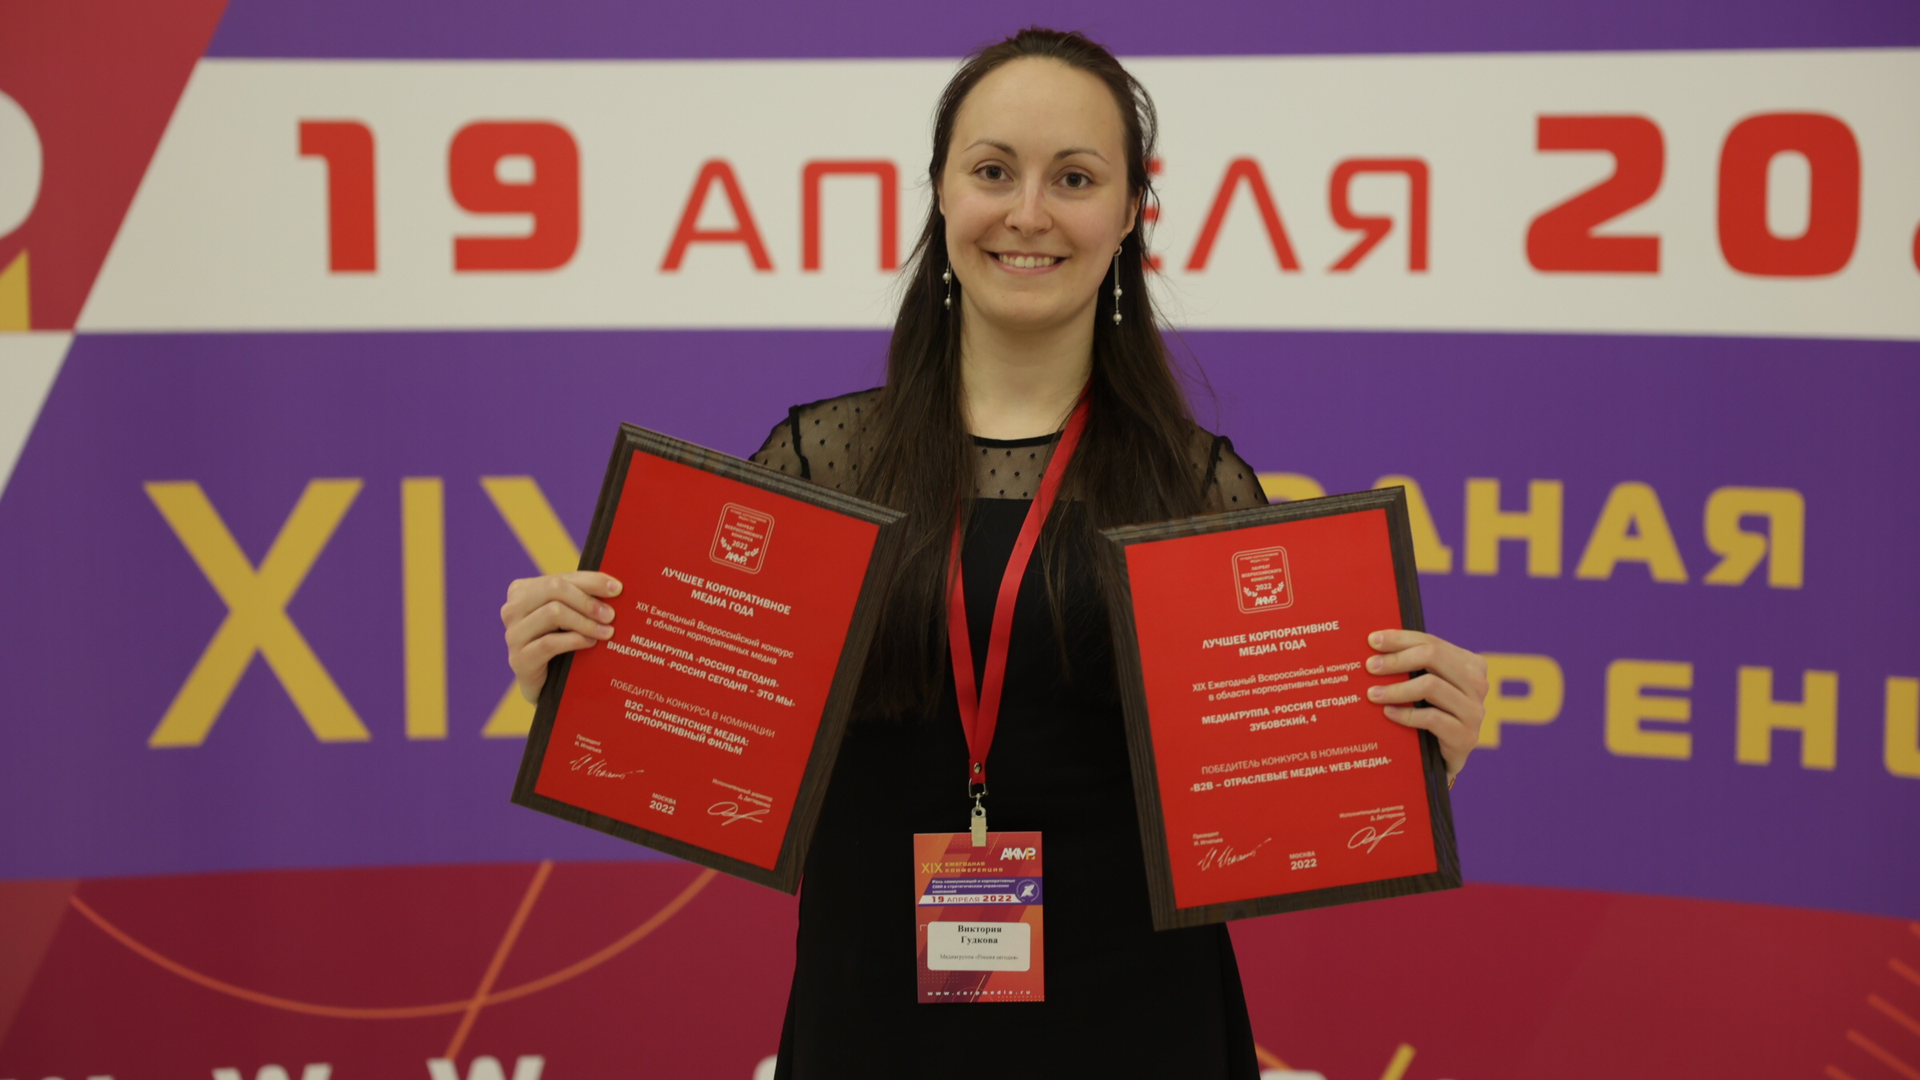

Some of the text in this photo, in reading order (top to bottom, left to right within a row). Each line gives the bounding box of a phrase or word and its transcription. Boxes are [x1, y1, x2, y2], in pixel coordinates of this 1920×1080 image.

[298, 118, 582, 275] 19
[1525, 110, 1920, 279] 20
[730, 539, 748, 550] 2022
[660, 566, 791, 615] ЛУЧШЕЕ КОРПОРАТИВНОЕ
[1255, 582, 1272, 591] 2022
[690, 588, 754, 617] МЕДИА ГОДА
[635, 600, 794, 658] XIX Ежегодный Всероссийский конкурс
[645, 617, 777, 665] в области корпоративных медиа
[1201, 620, 1339, 649] ЛУЧШЕЕ КОРПОРАТИВНОЕ
[629, 633, 693, 661] МЕДИАГРУППА
[1238, 638, 1307, 657] МЕДИА ГОДА
[606, 640, 665, 666] ВИДЕОРОЛИК
[707, 673, 748, 692] СЕГОДНЯ
[756, 688, 774, 701] ЭТО
[1191, 660, 1361, 692] XIX Ежегодный Всероссийский конкурс
[1207, 674, 1348, 701] в области корпоративных медиа
[609, 678, 775, 738] ПОБЕДИТЕЛЬ КОНКУРСА В НОМИНАЦИИ
[1200, 706, 1270, 724] МЕДИАГРУППА
[624, 710, 743, 755] КОРПОРАТИВНЫЙ ФИЛЬМ
[652, 708, 712, 734] КЛИЕНТСКИЕ
[713, 727, 749, 746] МЕДИА:
[1249, 713, 1317, 732] ЗУБОВСКИЙ, 4
[1201, 741, 1378, 774] ПОБЕДИТЕЛЬ КОНКУРСА В НОМИНАЦИИ
[1222, 770, 1289, 788] ОТРАСЛЕВЫЕ
[1289, 765, 1328, 778] МЕДИА:
[648, 799, 674, 815] 2022
[651, 792, 676, 805] МОСКВА
[921, 862, 943, 874] XIX
[1288, 850, 1315, 859] МОСКВА
[1290, 857, 1317, 870] 2022
[958, 925, 1002, 934] Виктория
[961, 936, 998, 945] Гудкова
